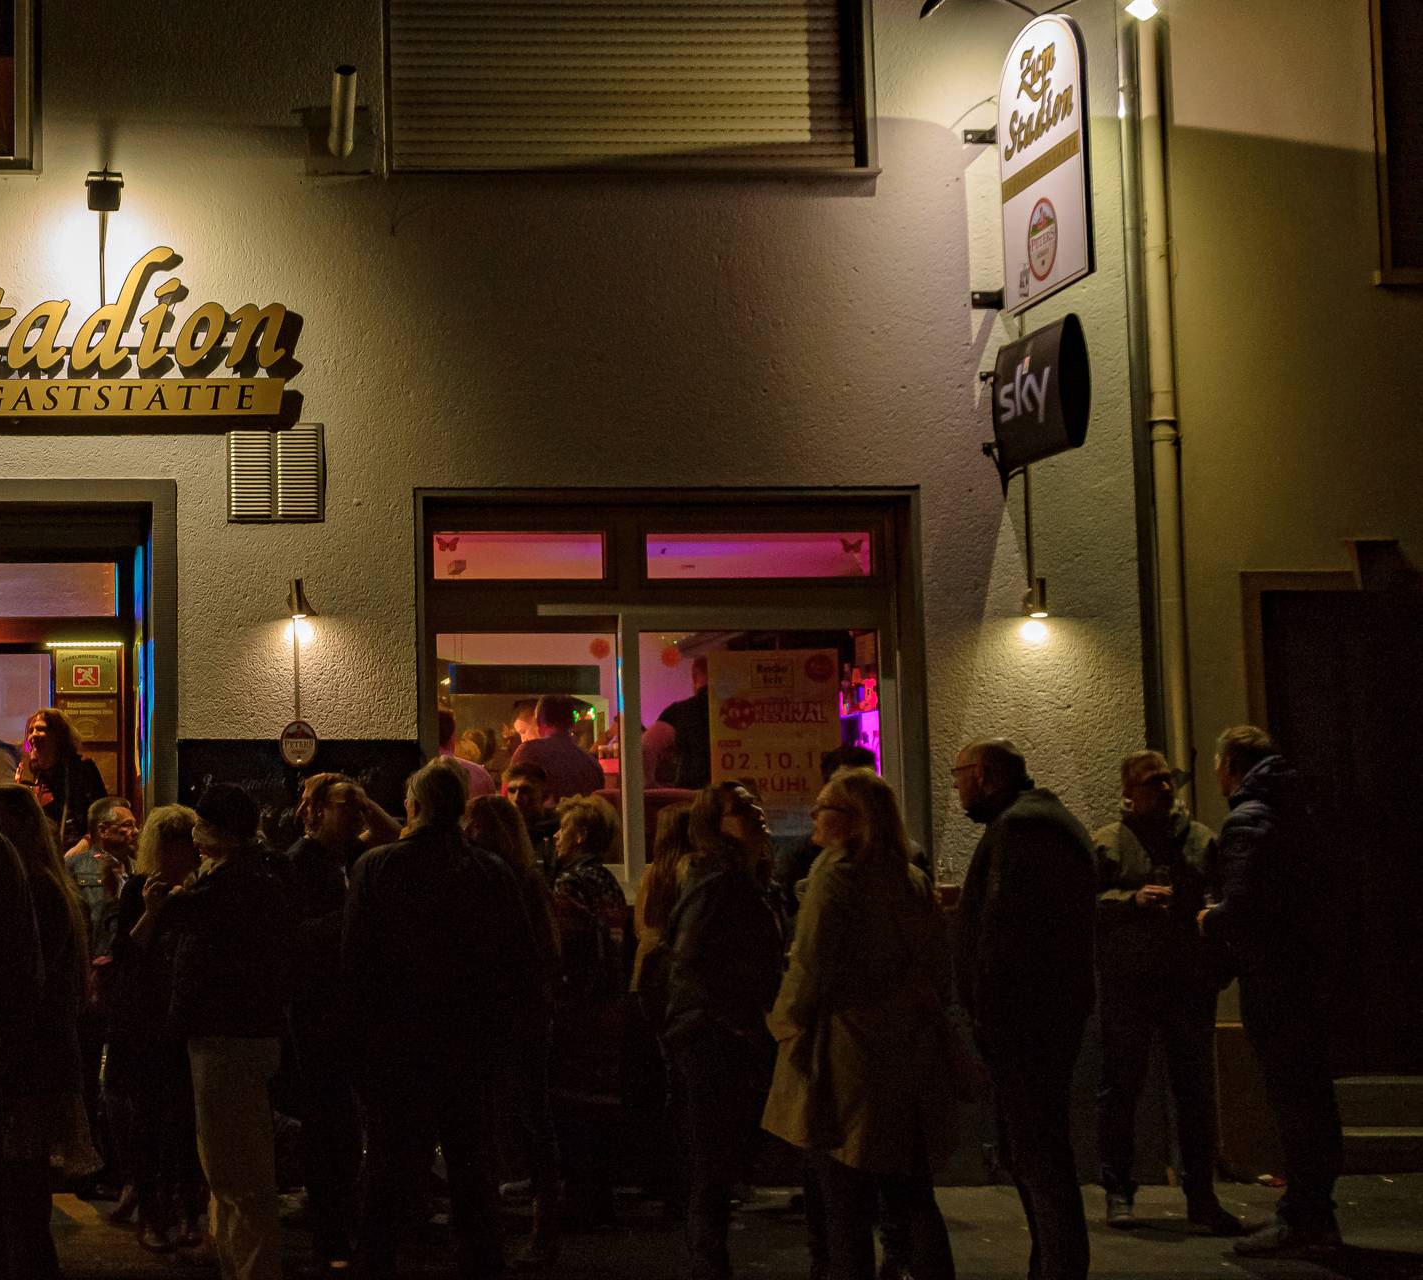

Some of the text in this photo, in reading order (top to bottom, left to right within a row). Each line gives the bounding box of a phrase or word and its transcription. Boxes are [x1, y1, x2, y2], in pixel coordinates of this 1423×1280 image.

[1017, 41, 1055, 102] Zum
[1005, 78, 1073, 161] Stadion
[1000, 362, 1051, 424] sky
[752, 774, 811, 792] RÜHL
